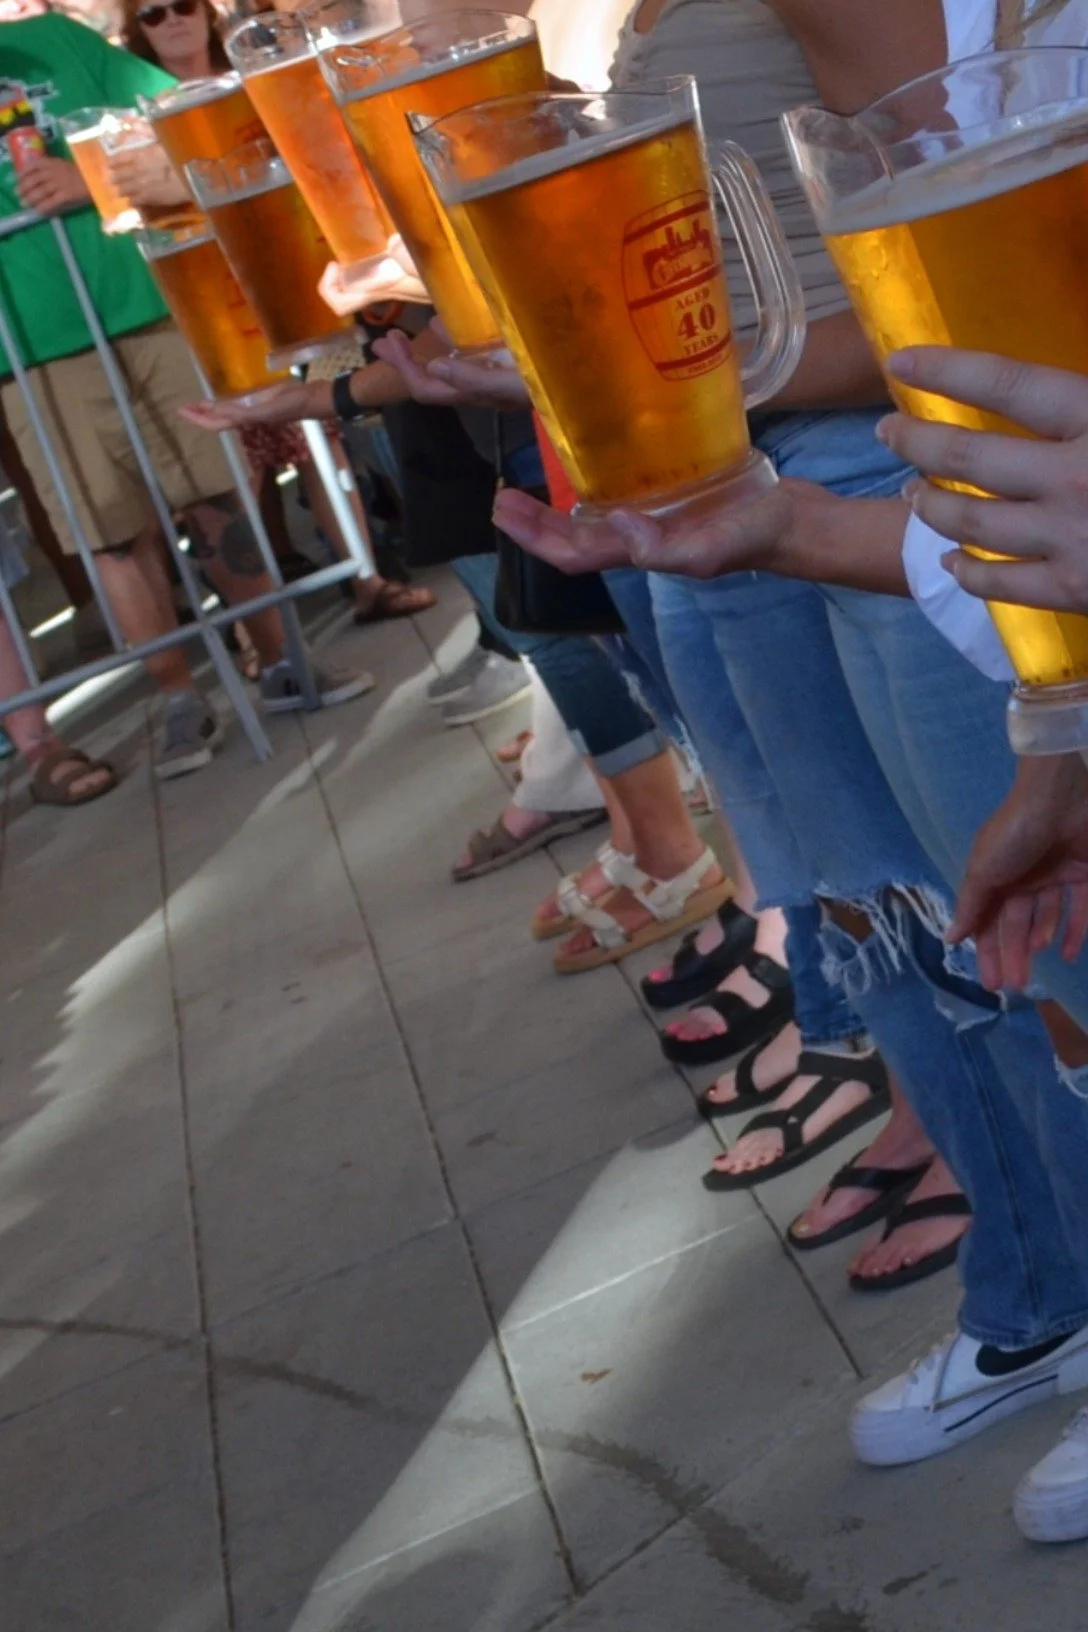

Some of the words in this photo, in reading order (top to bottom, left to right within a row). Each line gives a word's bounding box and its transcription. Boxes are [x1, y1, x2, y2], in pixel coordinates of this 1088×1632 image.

[676, 288, 710, 311] AGED
[679, 303, 715, 339] 40
[685, 335, 718, 355] YEARS
